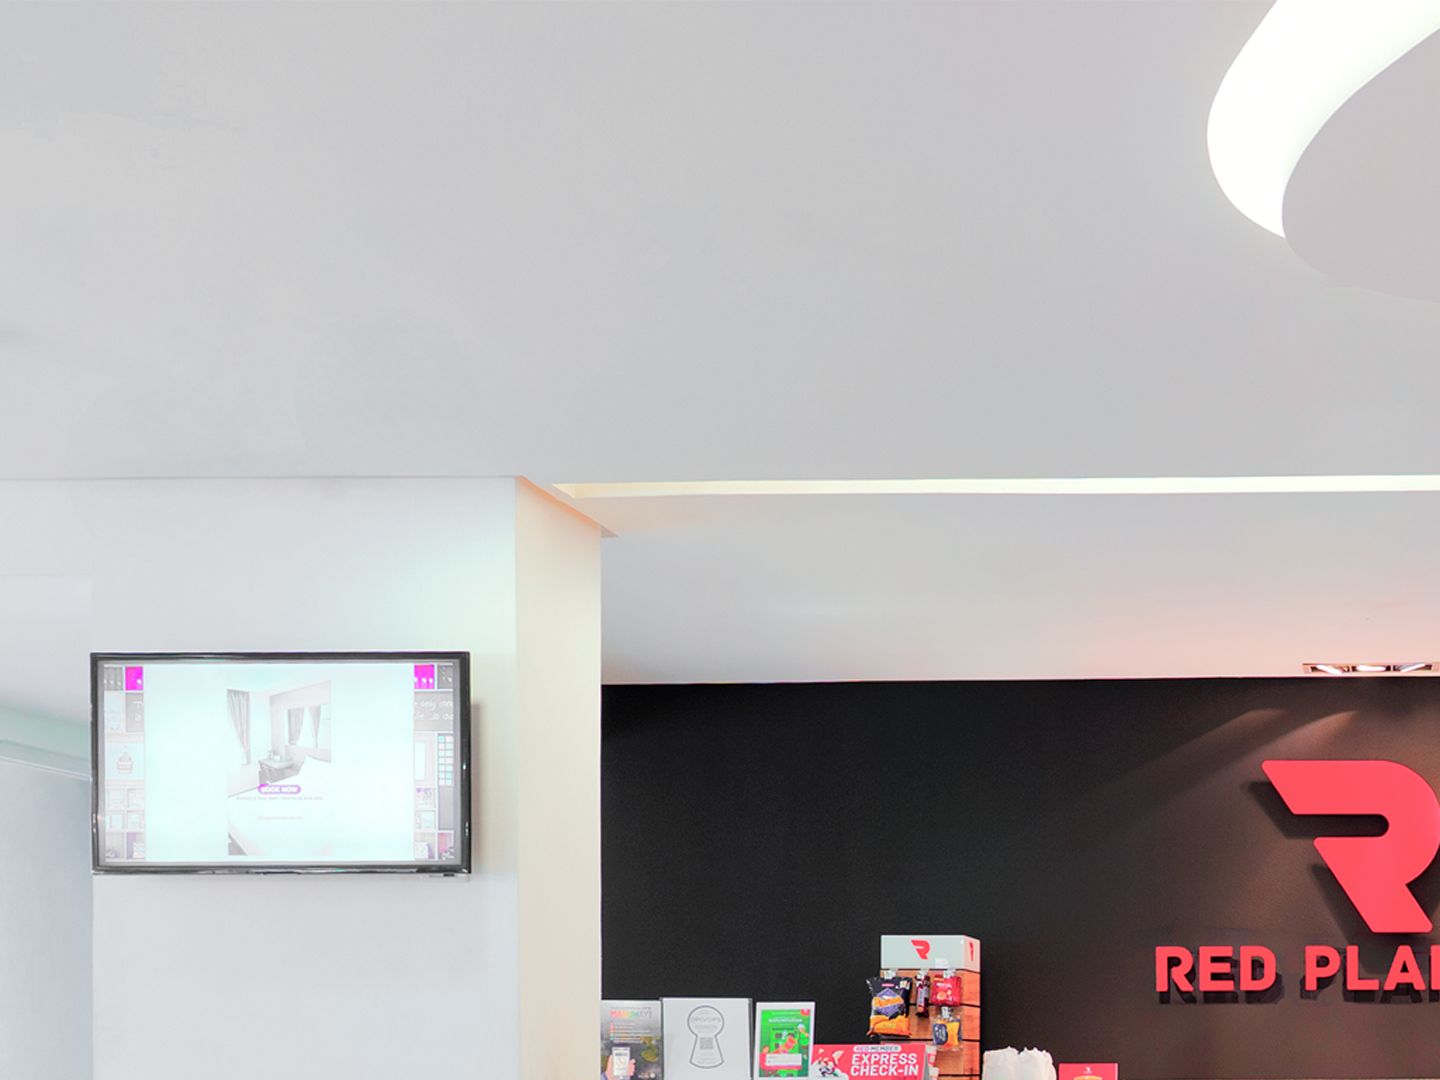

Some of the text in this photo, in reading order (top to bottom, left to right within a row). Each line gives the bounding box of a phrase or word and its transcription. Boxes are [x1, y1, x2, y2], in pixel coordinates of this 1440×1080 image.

[1156, 946, 1276, 992] RED
[851, 1053, 918, 1065] EXPRESS
[850, 1065, 919, 1077] CHECK-IN
